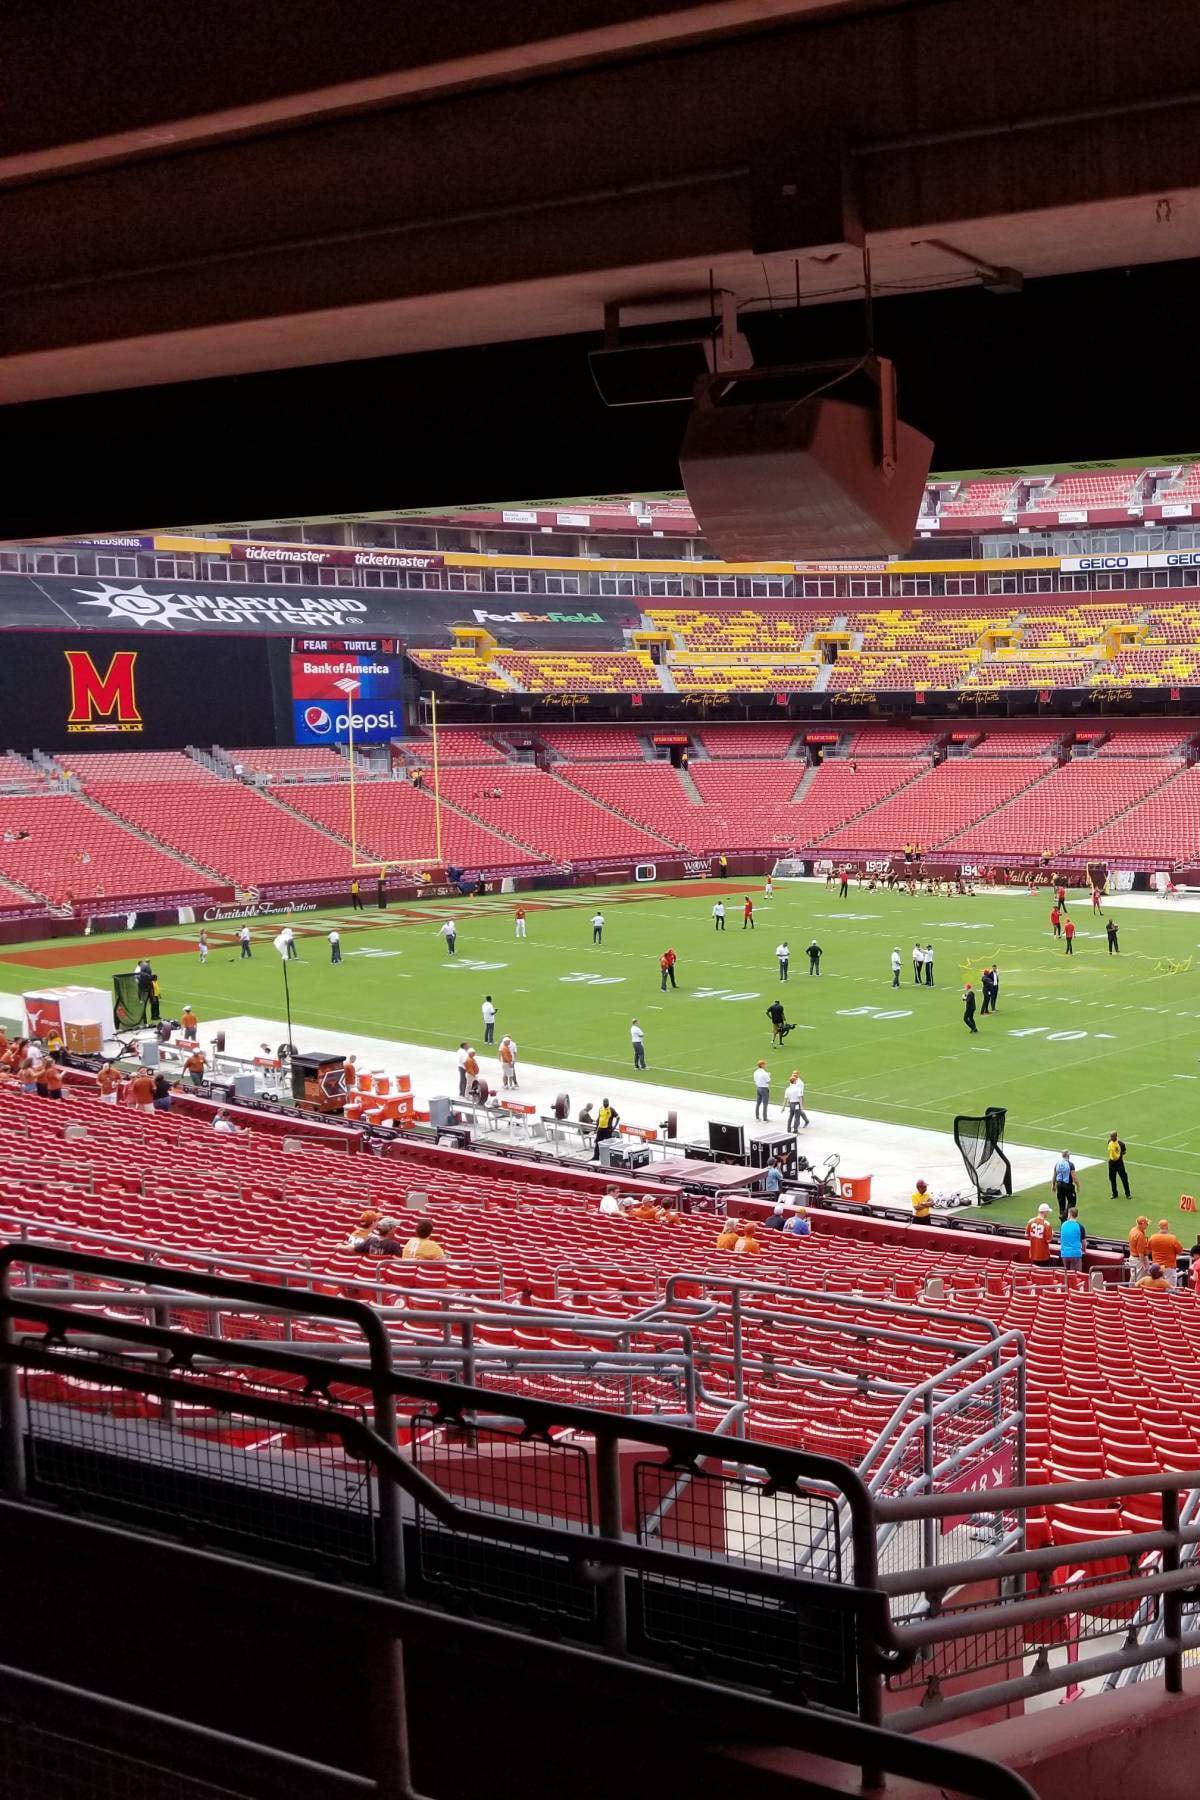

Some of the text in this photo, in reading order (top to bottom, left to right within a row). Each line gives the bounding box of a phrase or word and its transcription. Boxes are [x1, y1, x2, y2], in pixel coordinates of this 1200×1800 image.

[244, 547, 326, 563] ticketmaster
[354, 553, 430, 568] ticketmaster
[1079, 557, 1129, 570] GEICO
[177, 594, 368, 613] MARYLAND
[191, 608, 346, 626] LOTTERY
[472, 609, 605, 624] FedExField
[344, 641, 377, 651] TURTLE
[303, 662, 389, 674] Bank of America
[64, 651, 142, 721] M
[335, 710, 394, 734] pepsi
[203, 902, 317, 921] Charitable Foundation
[835, 1007, 914, 1020] 50
[1008, 1027, 1089, 1041] 40
[841, 1182, 853, 1198] G
[1180, 1195, 1192, 1210] 20
